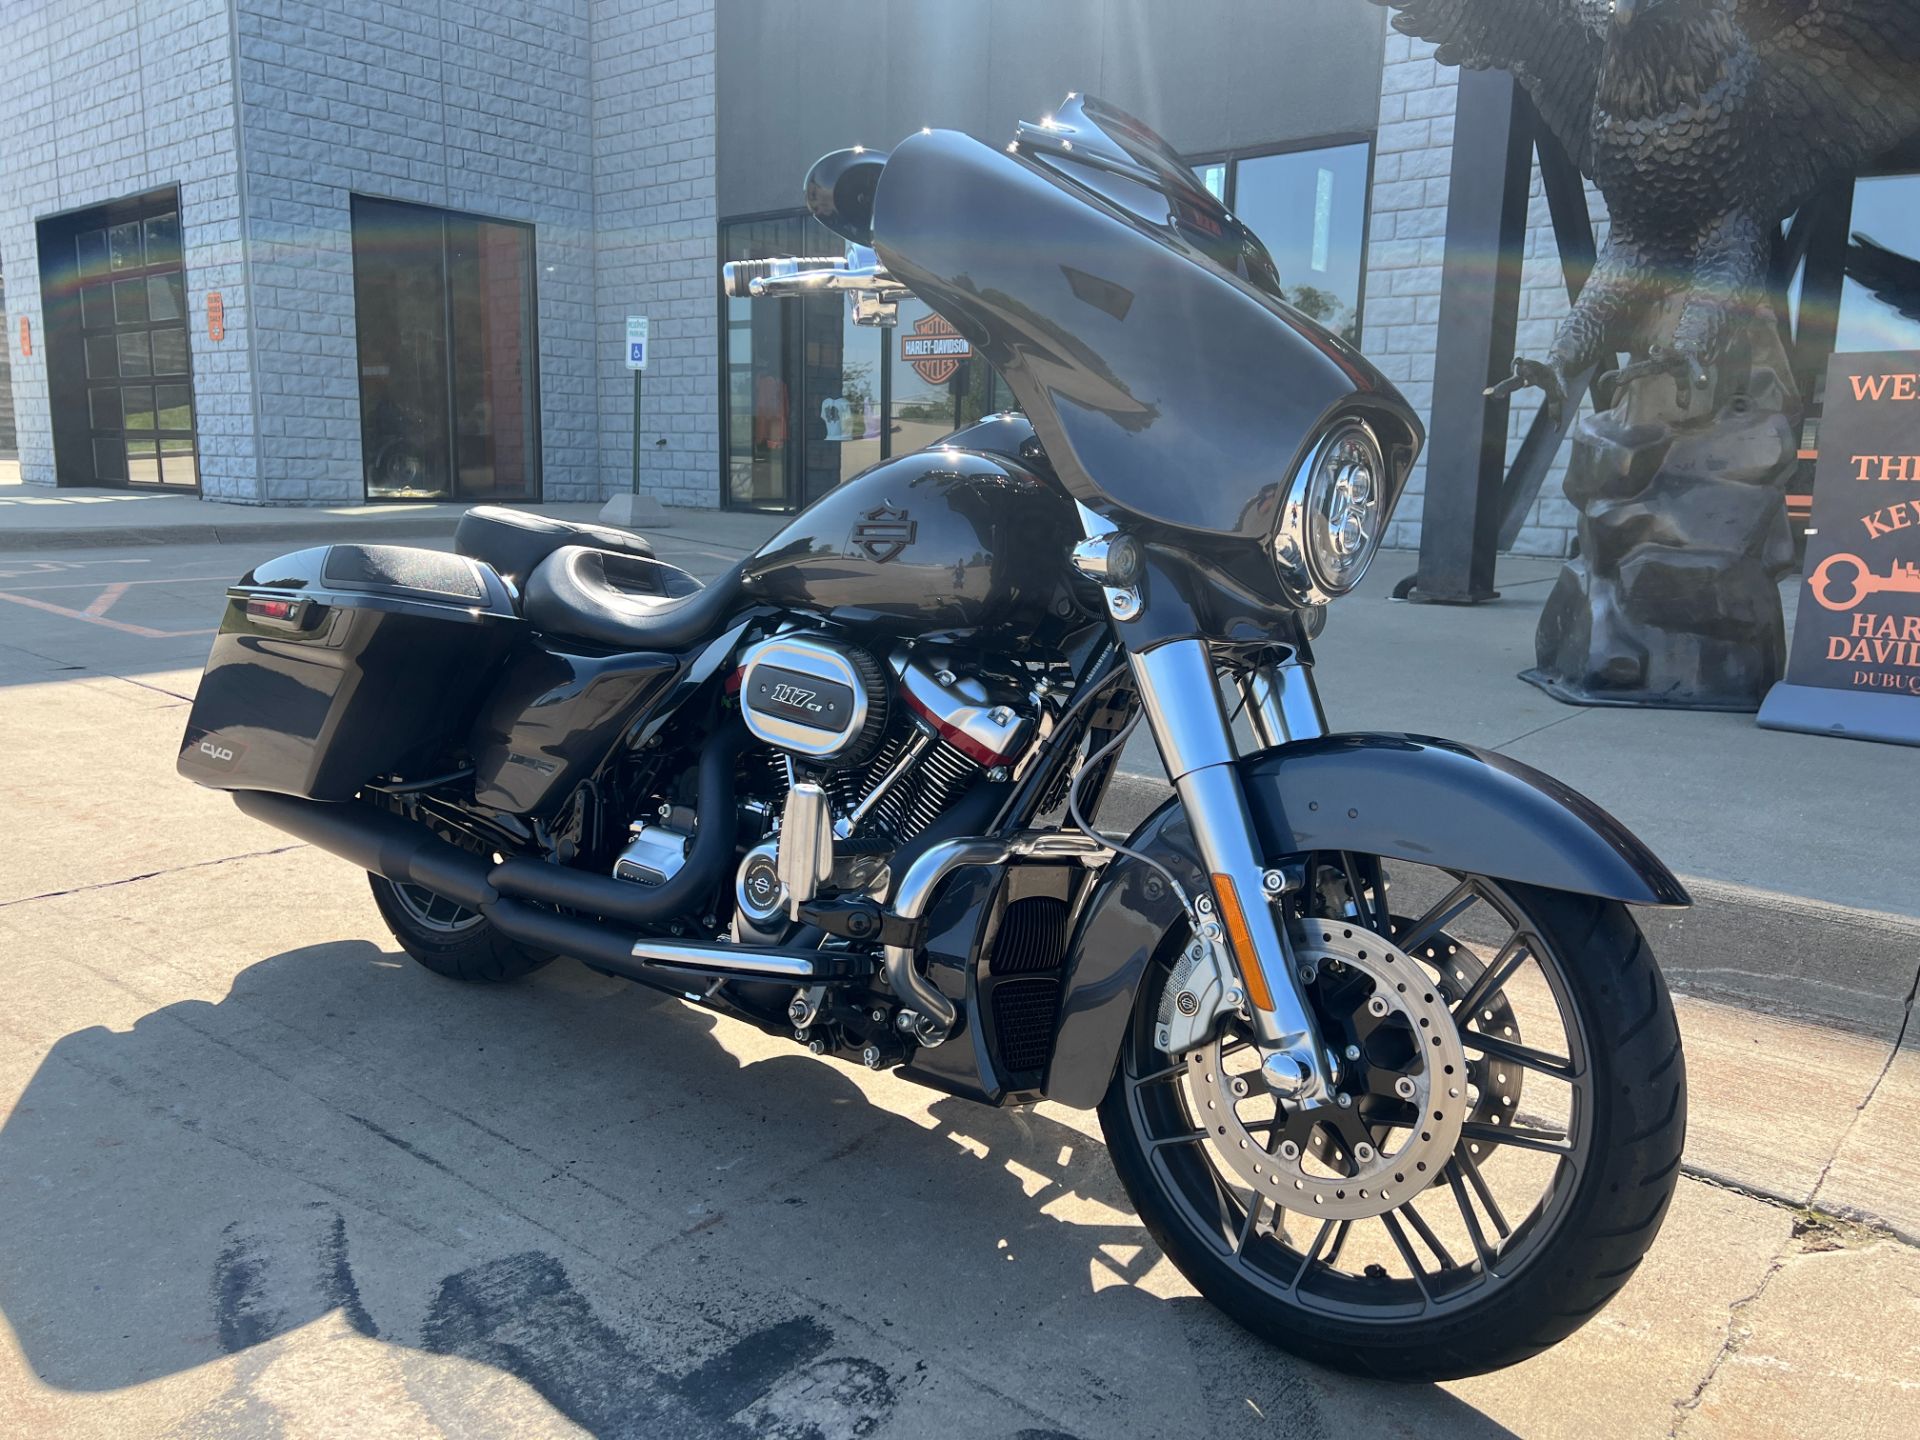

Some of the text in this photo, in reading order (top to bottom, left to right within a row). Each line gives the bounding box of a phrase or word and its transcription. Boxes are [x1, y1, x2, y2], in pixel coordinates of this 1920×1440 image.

[905, 339, 969, 355] HARLEY-DAVIDSON
[1848, 374, 1920, 400] WE
[1850, 613, 1920, 640] HAR
[771, 684, 816, 707] 117
[201, 742, 233, 760] CVO
